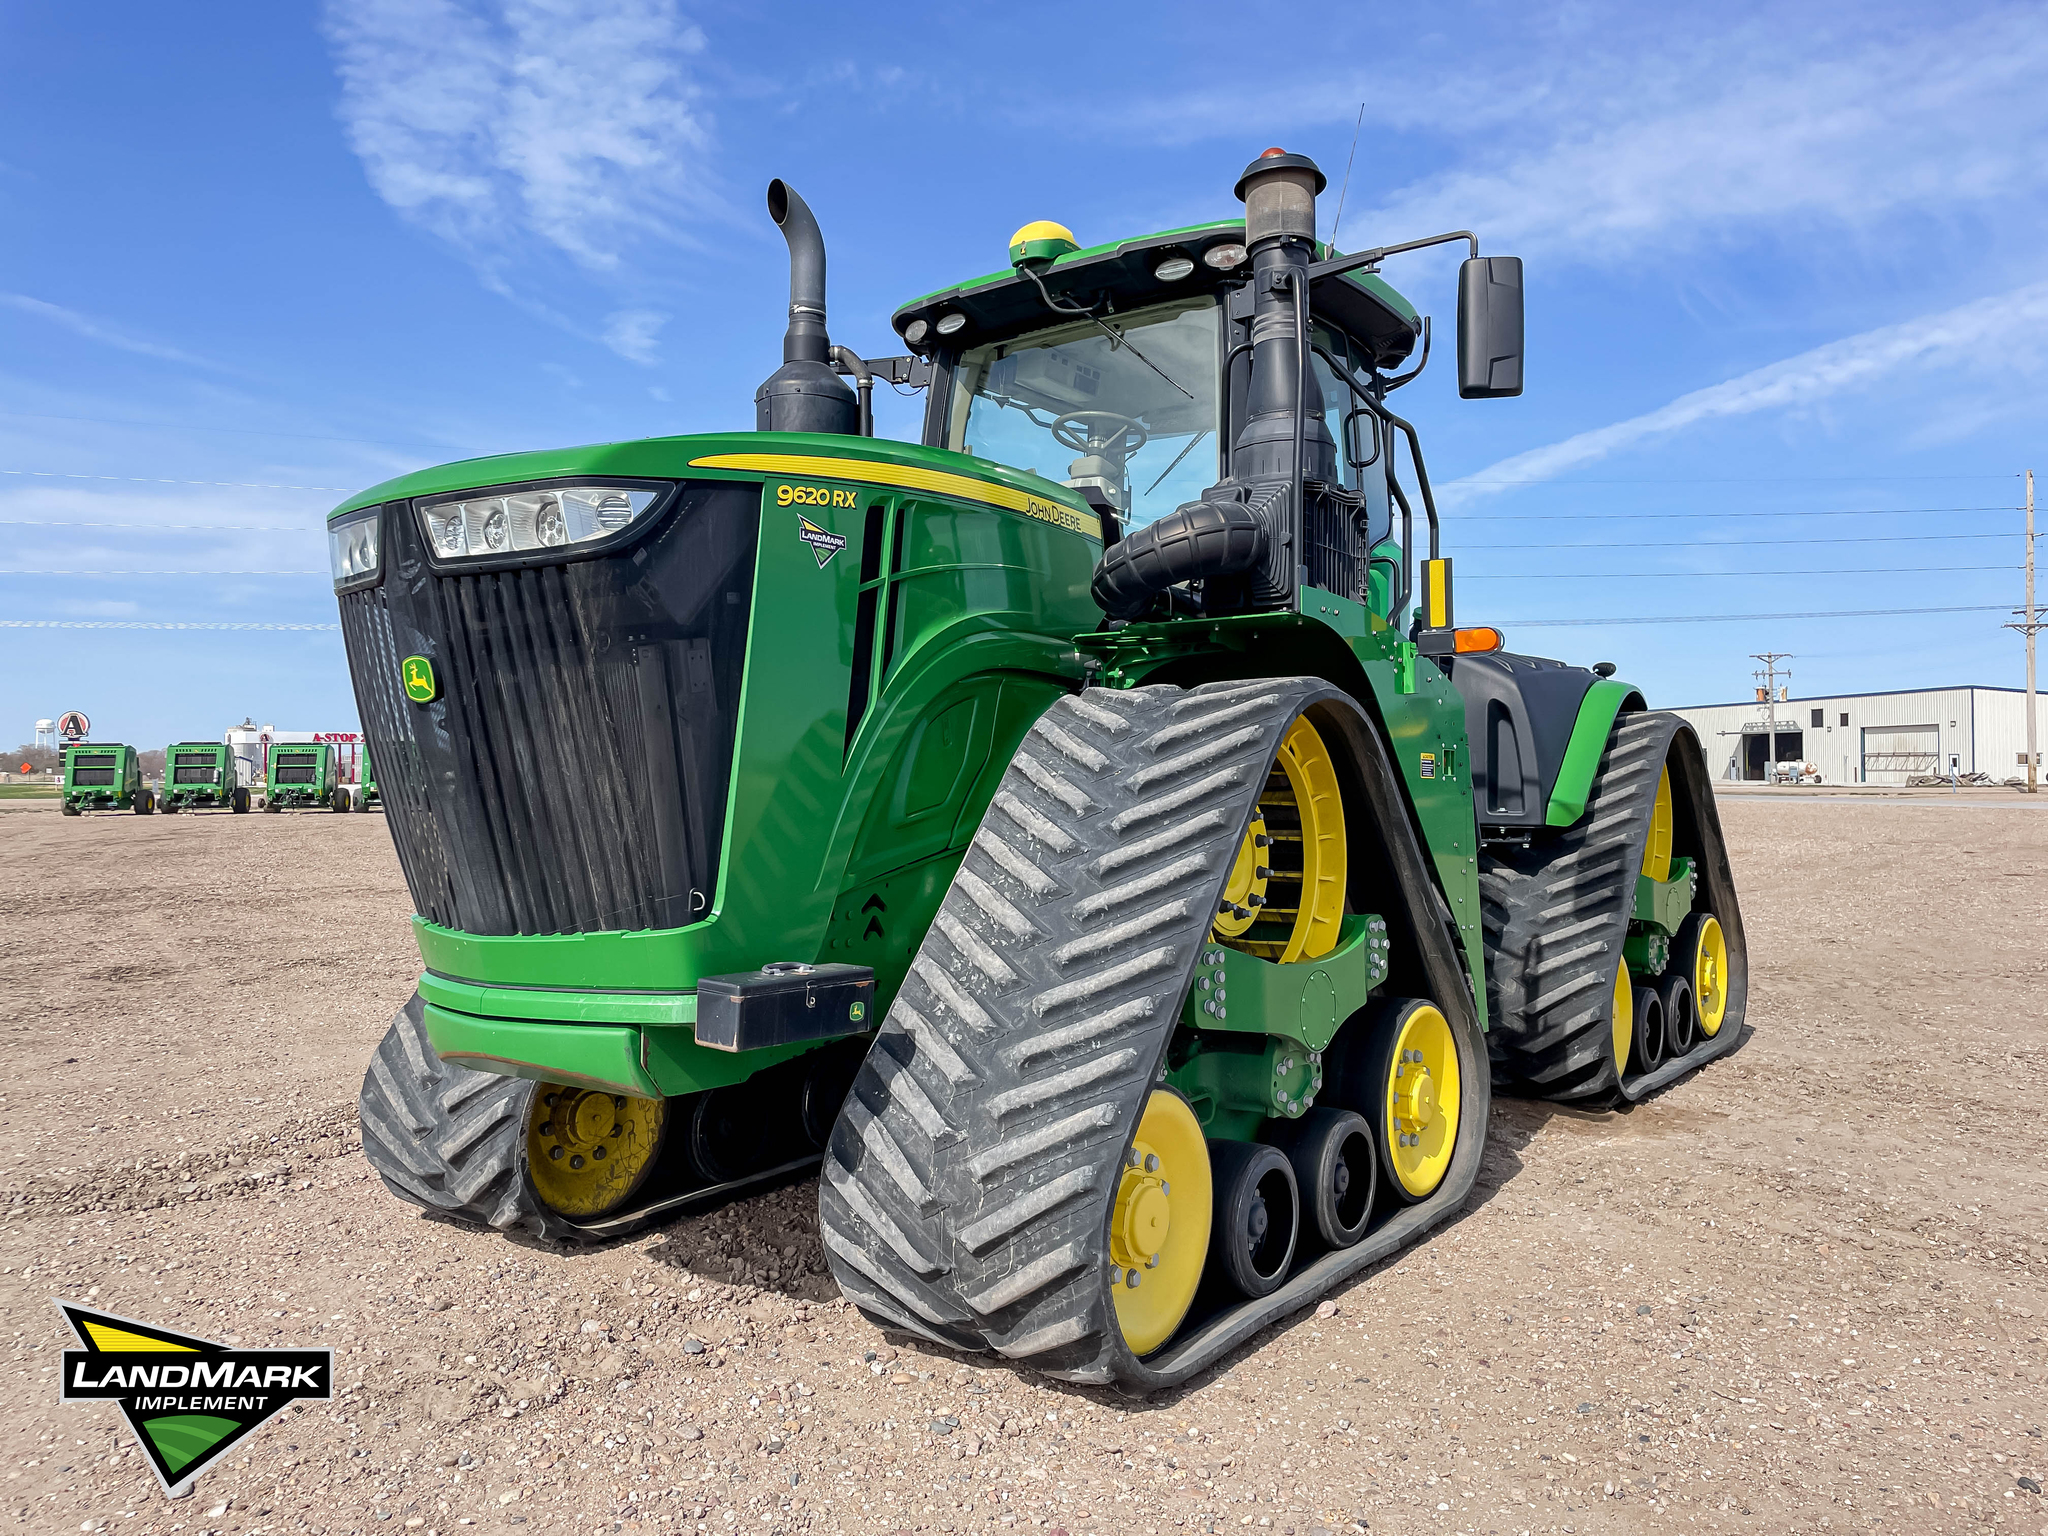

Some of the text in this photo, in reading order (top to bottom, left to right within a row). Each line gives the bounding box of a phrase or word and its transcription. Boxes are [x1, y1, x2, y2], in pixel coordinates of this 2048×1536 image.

[777, 485, 858, 509] 9620 RX
[1026, 497, 1082, 532] JOHN DEERE
[812, 541, 837, 550] IMPLEMENT
[312, 733, 358, 742] A-STOP
